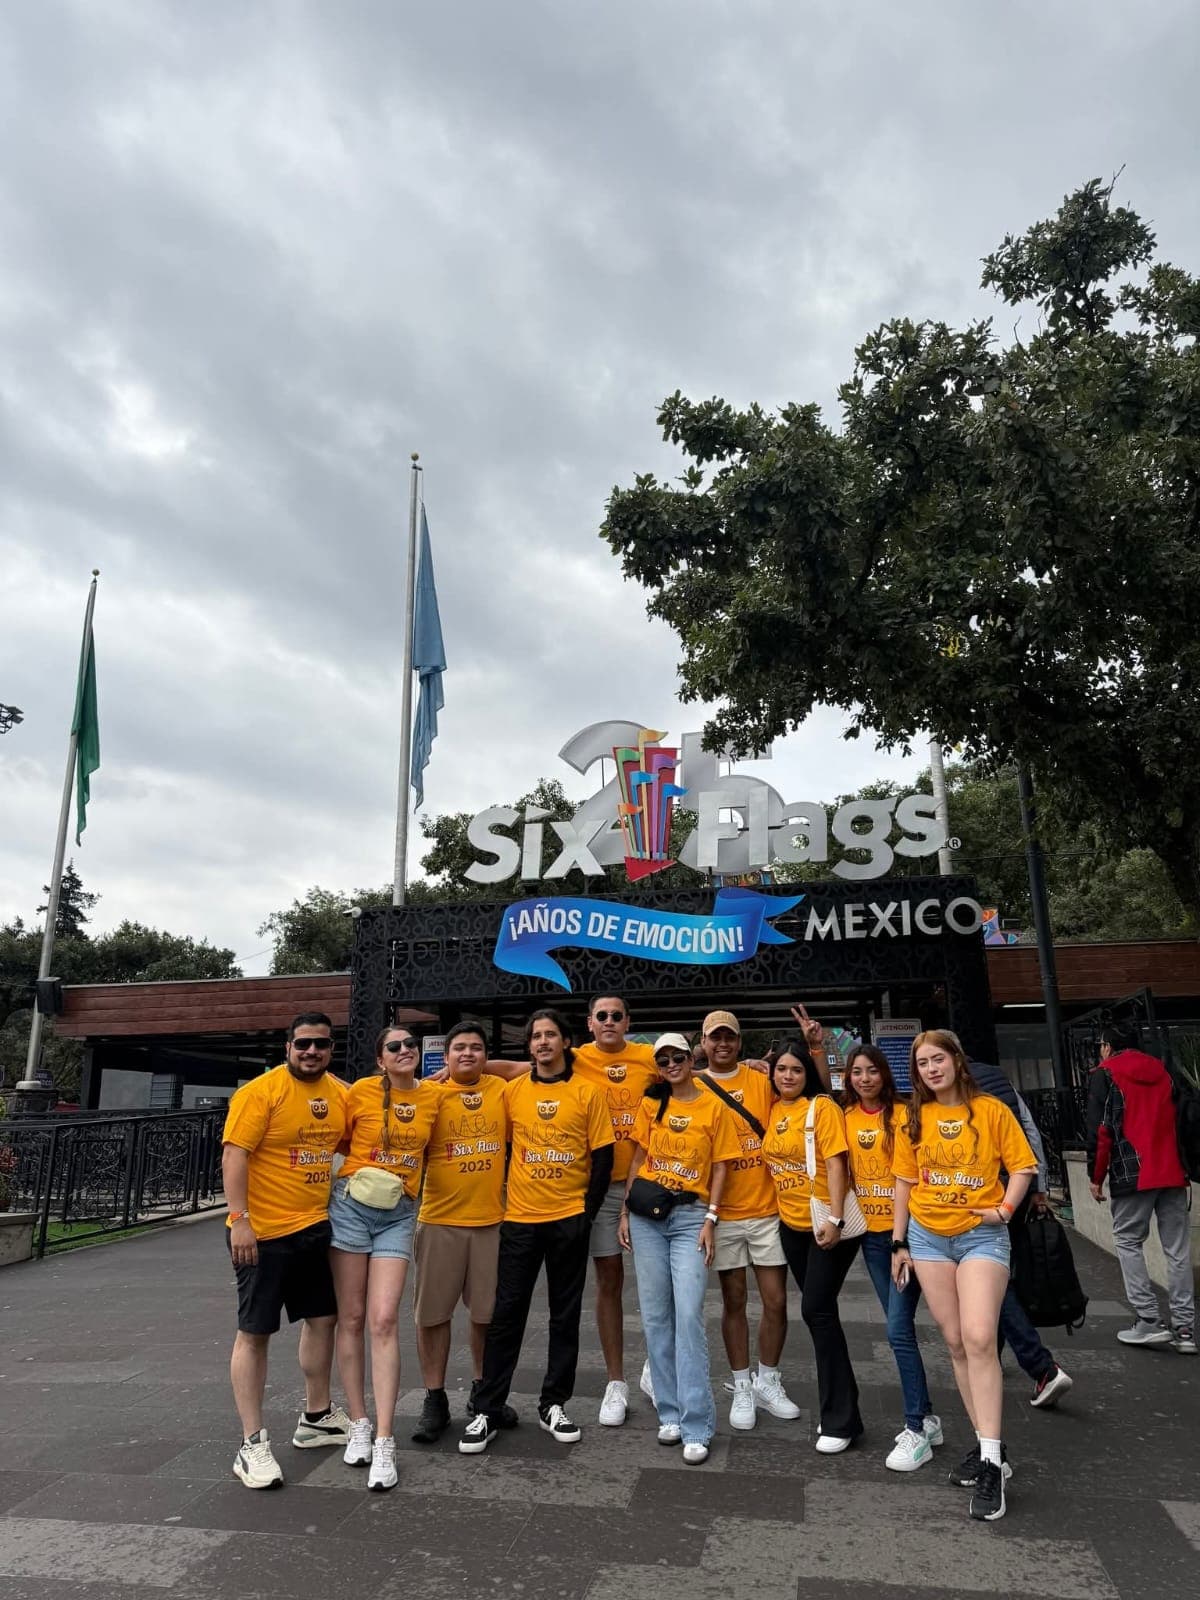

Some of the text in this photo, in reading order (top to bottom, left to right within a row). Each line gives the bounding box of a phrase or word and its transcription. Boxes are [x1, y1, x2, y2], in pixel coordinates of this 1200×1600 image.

[463, 785, 949, 884] Six Flags
[803, 896, 984, 942] MEXICO
[509, 903, 745, 954] ¡AÑOS DE EMOCIÓN!
[453, 1142, 474, 1157] Six
[526, 1149, 577, 1166] Six Flags
[299, 1151, 318, 1166] Six
[459, 1158, 492, 1173] 2025
[731, 1155, 763, 1172] 2025
[304, 1170, 331, 1185] 2025
[530, 1167, 563, 1180] 2025
[653, 1158, 699, 1181] Six Flags
[776, 1174, 806, 1192] 2025
[929, 1171, 985, 1190] Six Flags
[855, 1183, 896, 1202] Six Flag
[934, 1191, 969, 1206] 2025
[863, 1203, 892, 1217] 2025
